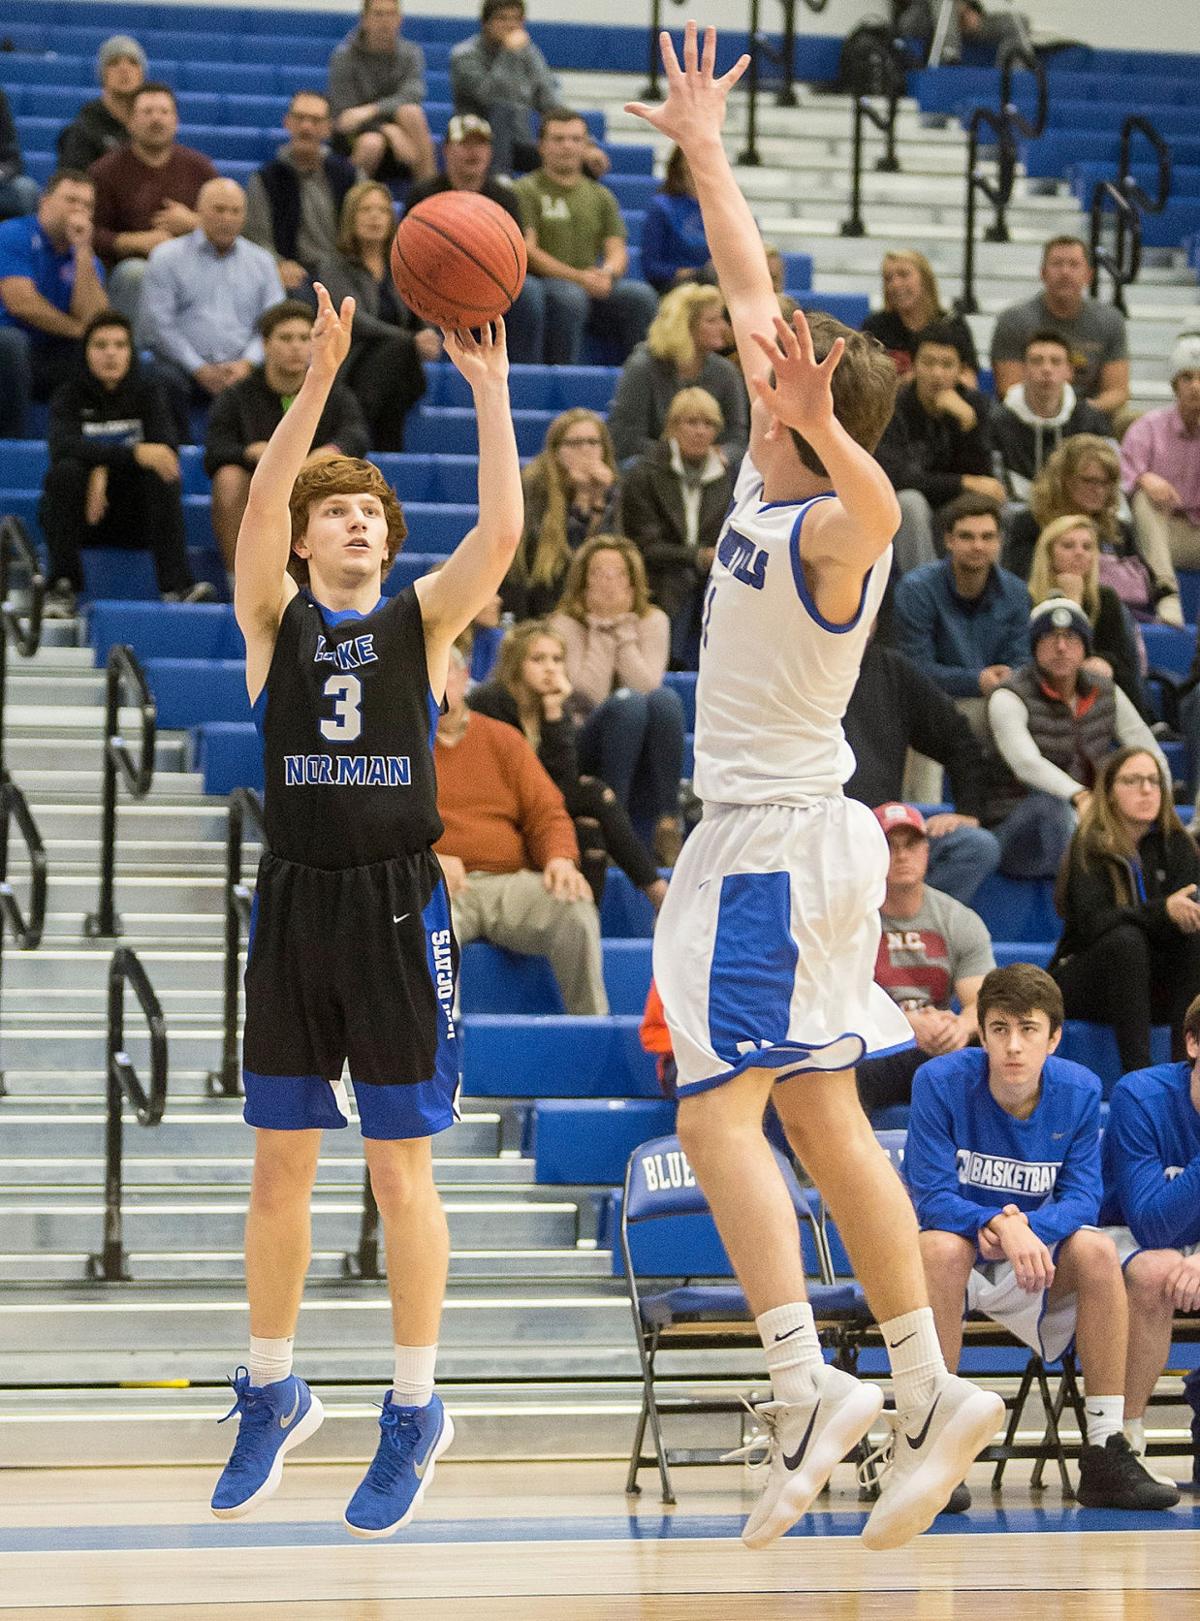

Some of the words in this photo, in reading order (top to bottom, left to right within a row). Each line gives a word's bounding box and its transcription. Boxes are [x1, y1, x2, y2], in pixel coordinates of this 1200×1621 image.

[319, 673, 363, 742] 3
[284, 754, 411, 786] NORMAN
[431, 929, 455, 1040] DCATS
[642, 1151, 696, 1191] BLUE
[970, 1156, 1057, 1193] BASKETBA
